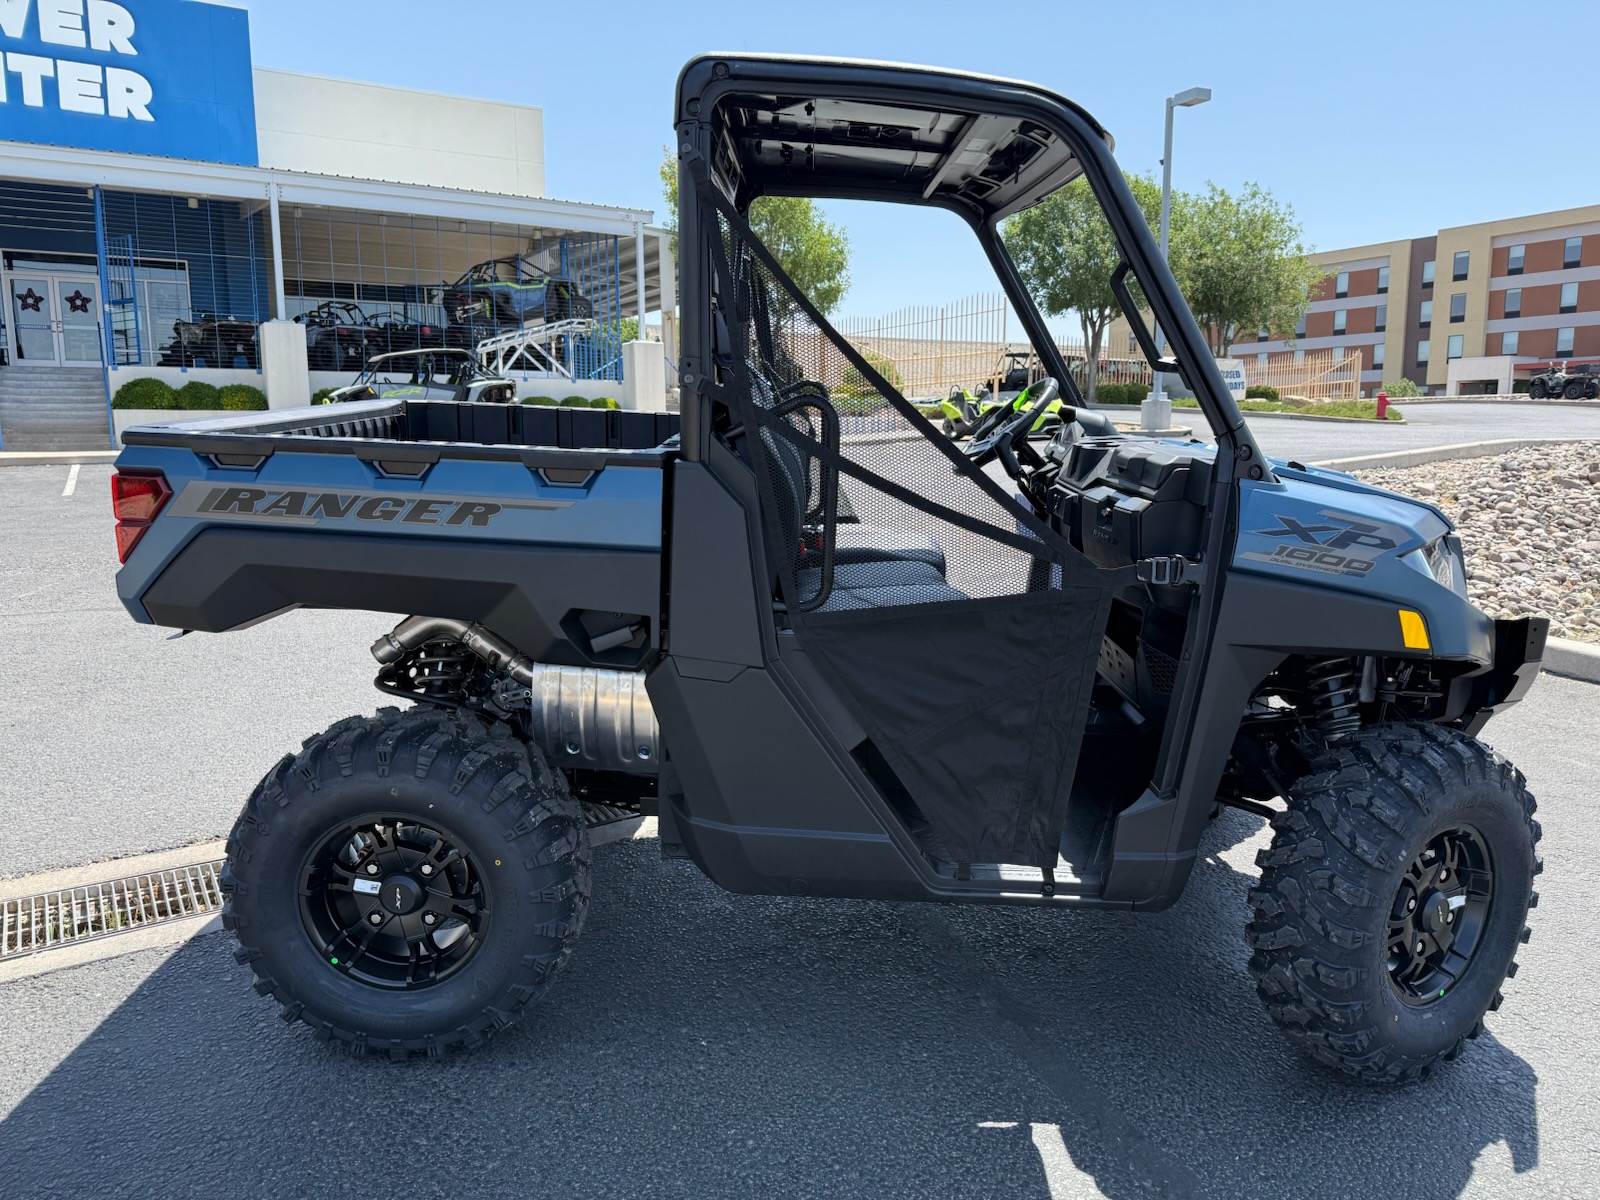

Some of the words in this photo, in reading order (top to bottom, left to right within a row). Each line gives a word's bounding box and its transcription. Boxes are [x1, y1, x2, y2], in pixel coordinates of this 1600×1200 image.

[0, 51, 155, 122] TER
[209, 487, 502, 528] RANGER
[1245, 513, 1398, 551] XP
[1269, 557, 1293, 565] DUAL
[1295, 562, 1344, 574] OVERHEAD
[1273, 543, 1376, 574] 1000
